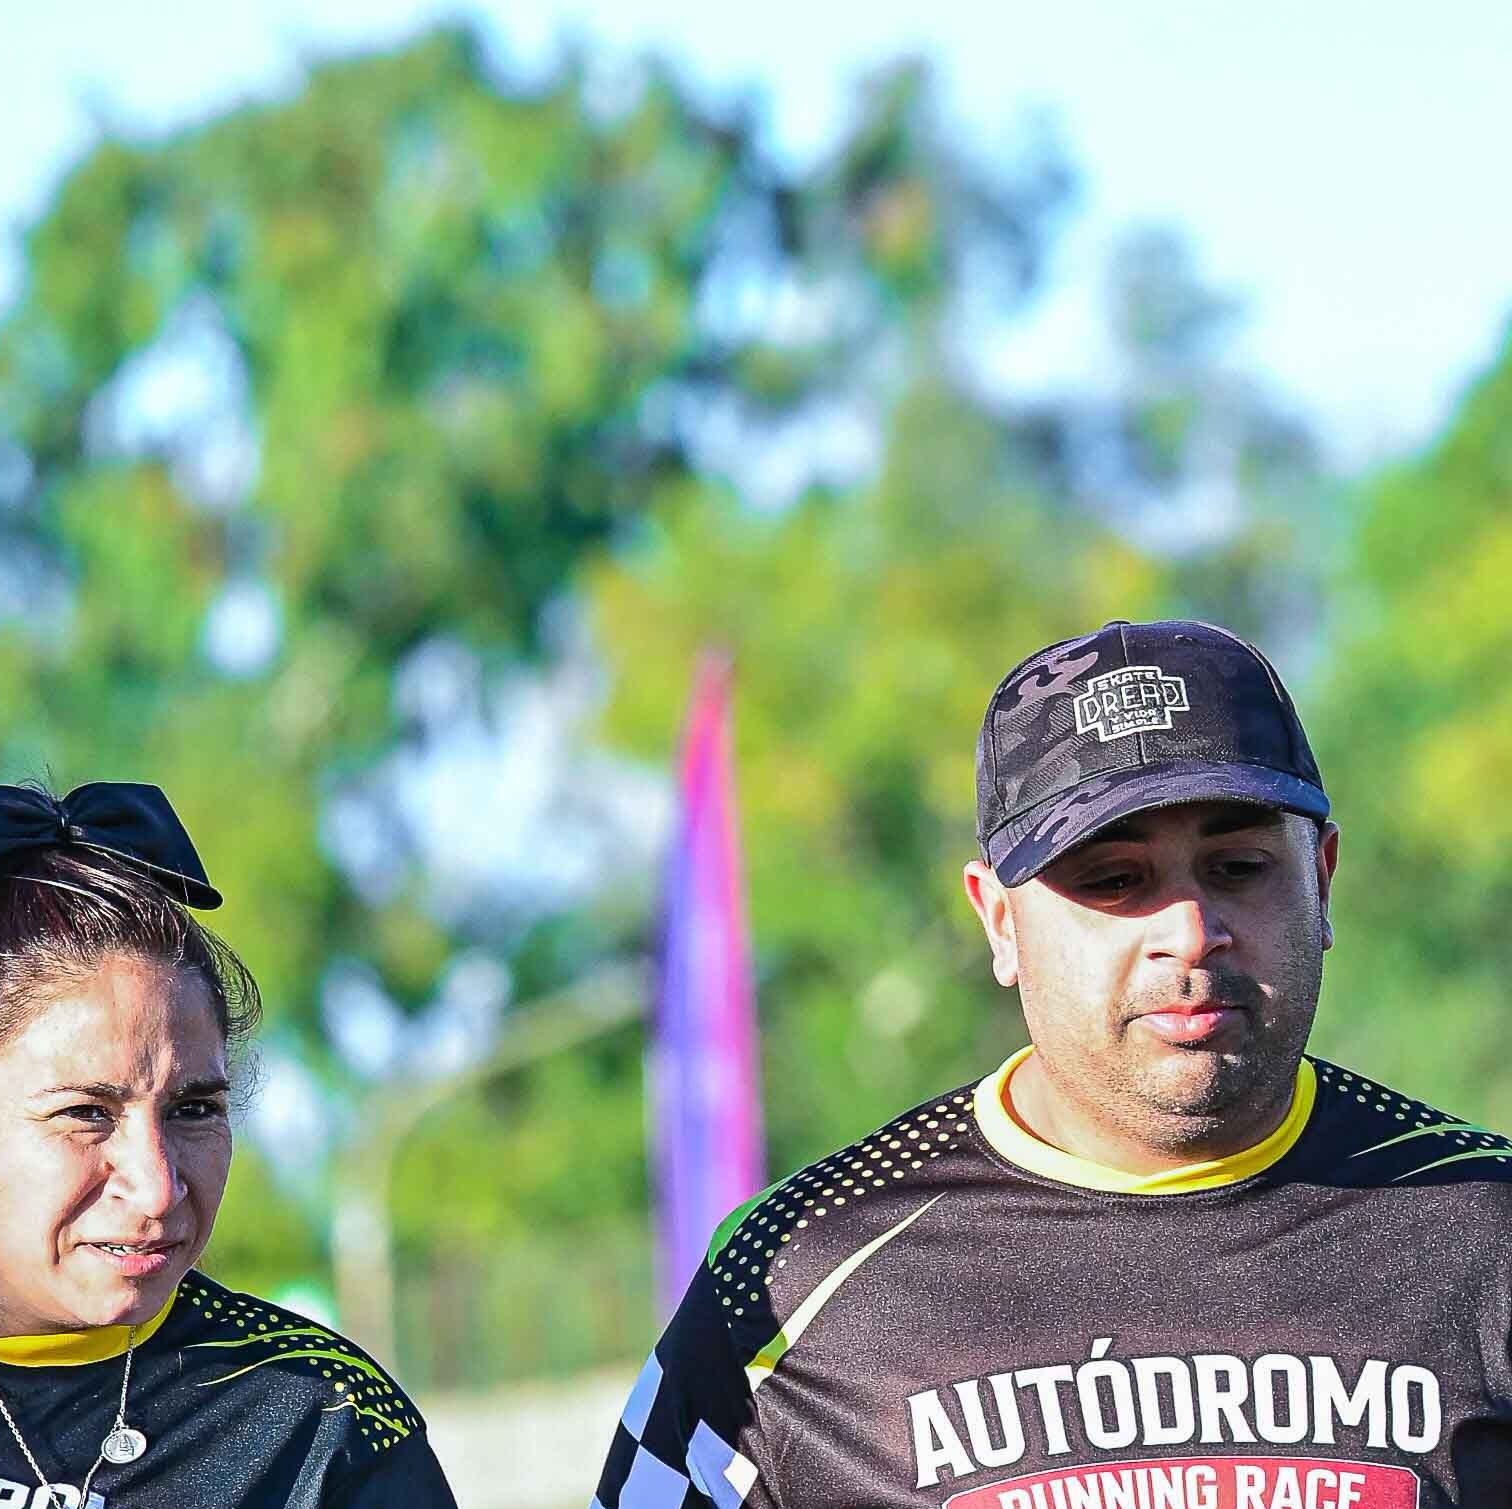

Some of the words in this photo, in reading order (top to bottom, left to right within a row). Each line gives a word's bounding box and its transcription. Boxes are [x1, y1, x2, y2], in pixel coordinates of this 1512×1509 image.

[1097, 671, 1156, 691] SKATE
[1082, 682, 1180, 723] DREAD
[907, 1337, 1442, 1489] AUTÓDROMO
